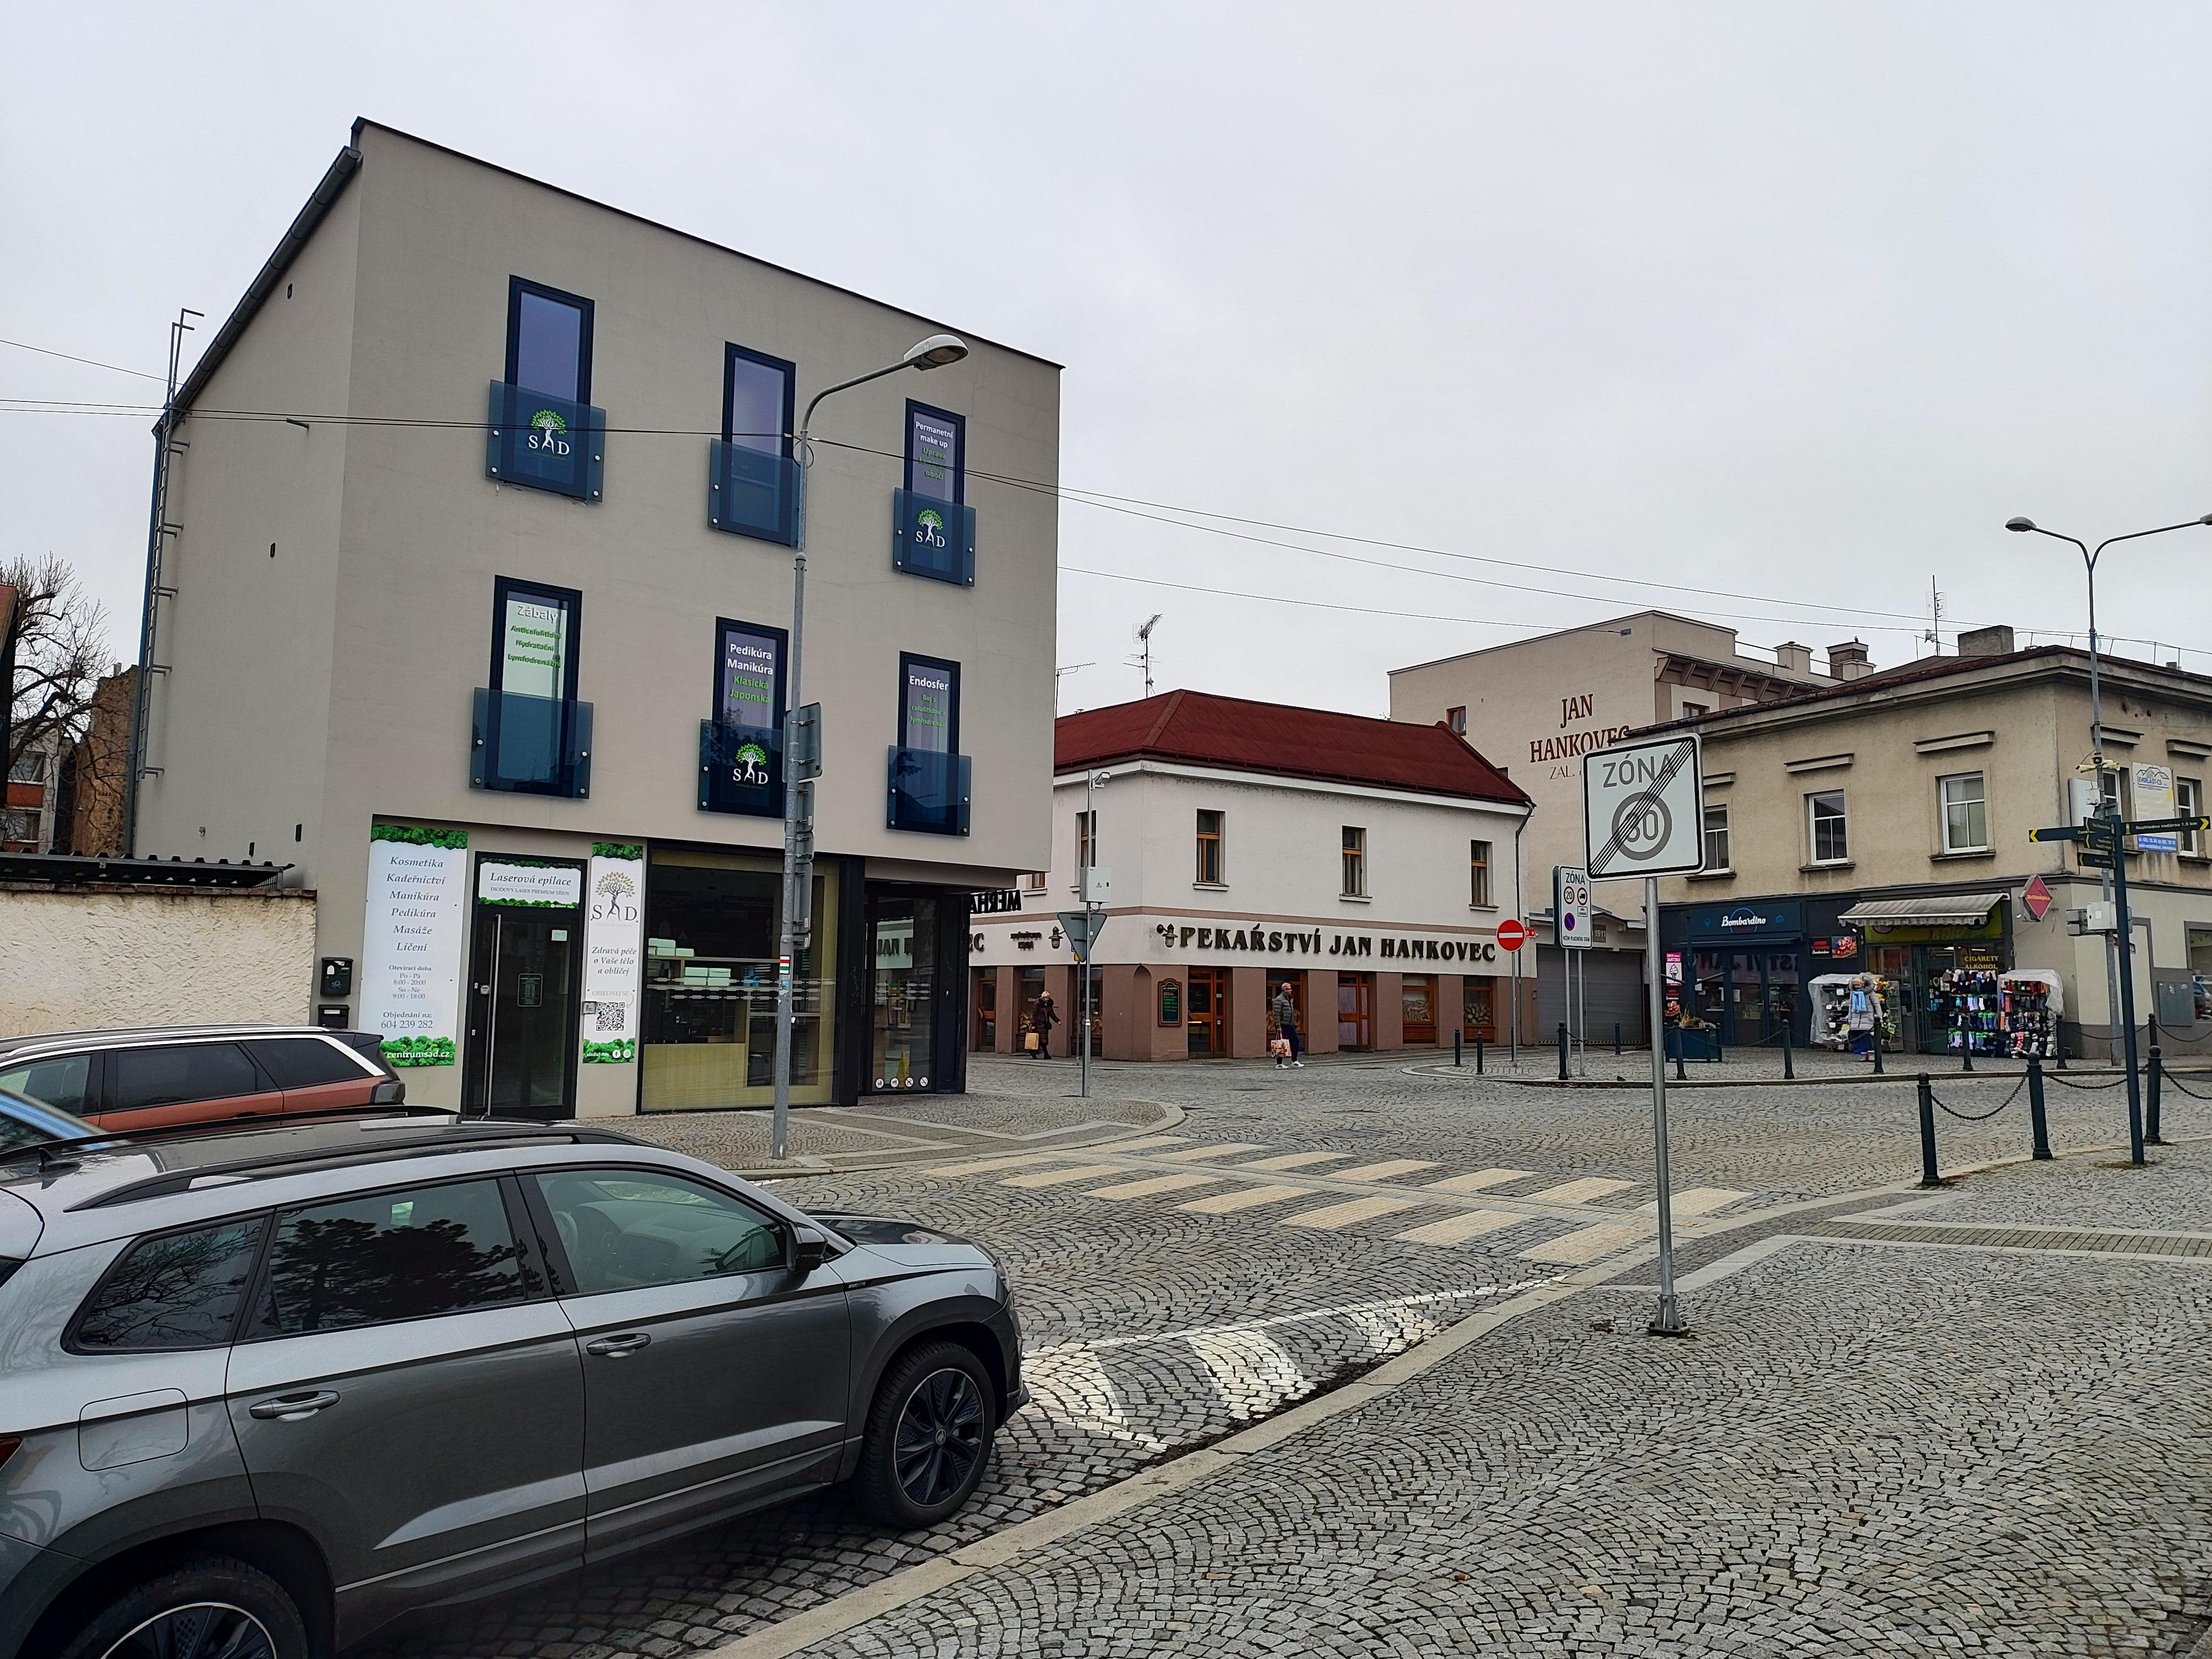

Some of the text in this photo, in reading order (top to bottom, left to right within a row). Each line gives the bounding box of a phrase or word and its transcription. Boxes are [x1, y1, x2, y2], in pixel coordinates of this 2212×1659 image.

[915, 421, 953, 439] Permanetní
[528, 435, 570, 455] SAD
[920, 435, 938, 445] make
[916, 531, 946, 547] SAD
[518, 606, 559, 623] Zábaly
[730, 643, 772, 660] Pedikúra
[727, 658, 773, 675] Manikúra
[734, 675, 769, 690] Klasická
[910, 675, 949, 691] Endosfer
[729, 689, 771, 704] Japonská
[922, 695, 932, 703] Boj
[1560, 693, 1594, 729] JAN
[733, 768, 769, 785] SAD
[1550, 765, 1575, 780] ZAL.
[1603, 753, 1677, 788] ZÓNA
[390, 856, 443, 868] Kosmetika
[387, 873, 446, 885] Kadeřnictví
[491, 872, 571, 886] Laserová epilace
[1566, 871, 1585, 885] ZÓNA
[389, 890, 439, 901] Manikúra
[1566, 891, 1573, 900] 20
[391, 907, 436, 918] Pedikúra
[592, 904, 638, 922] SAD
[1721, 915, 1766, 927] Bombardino
[393, 925, 432, 935] Masáže
[397, 942, 428, 951] Líčení
[620, 948, 637, 956] péče
[1329, 935, 1372, 957] JAN
[1380, 938, 1496, 962] HANKOVEC
[604, 967, 629, 977] obličej
[381, 1020, 433, 1029] 604 239 282
